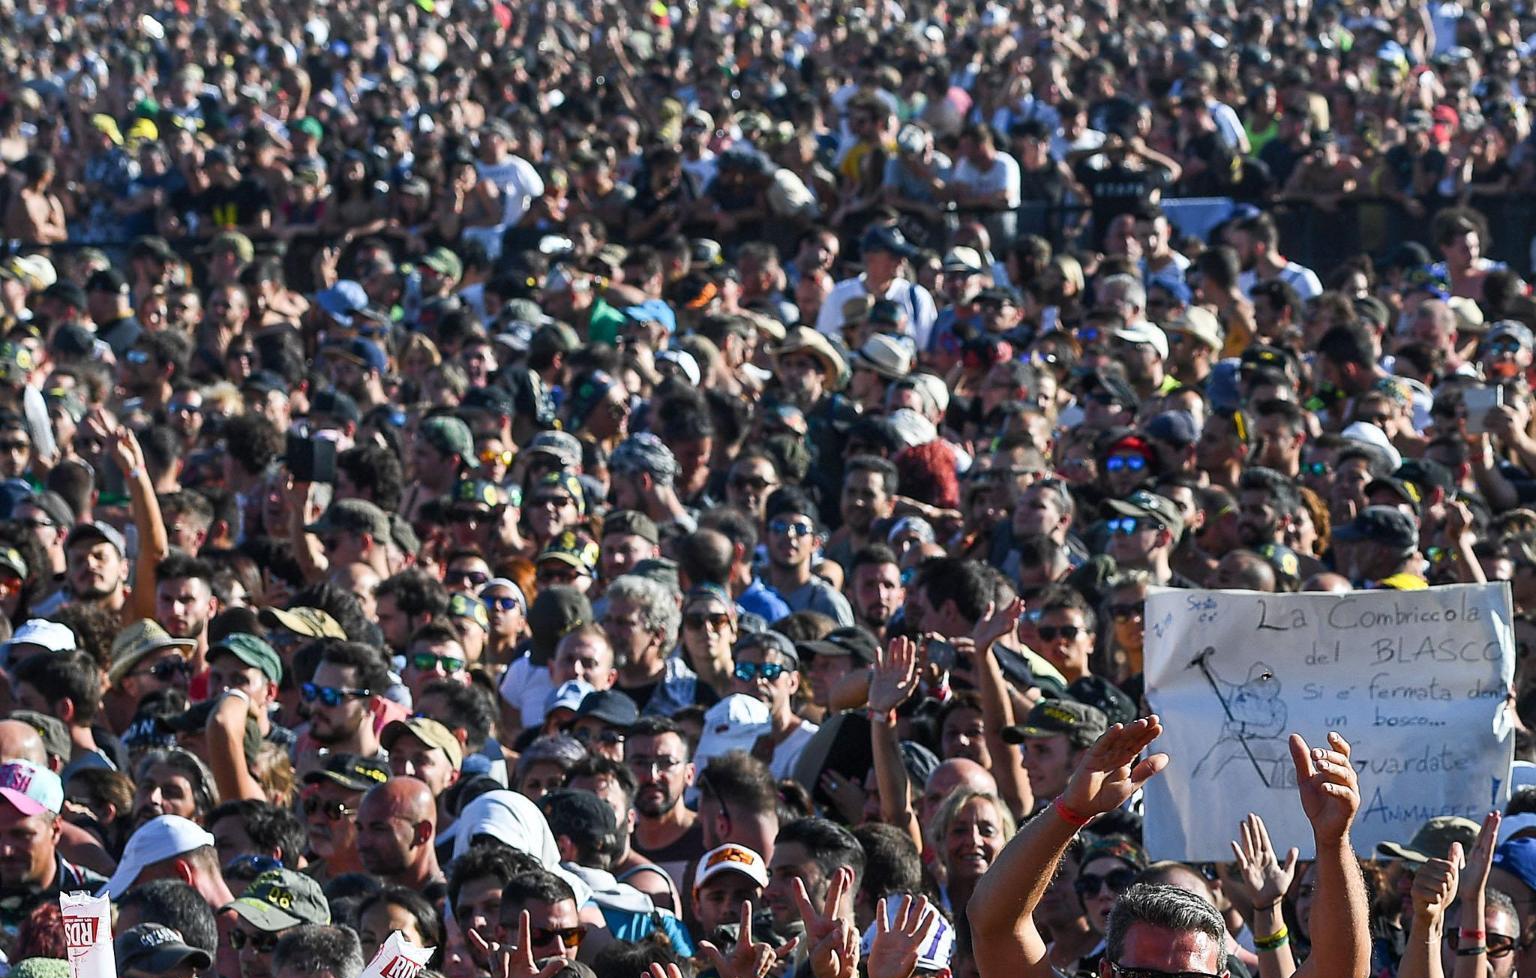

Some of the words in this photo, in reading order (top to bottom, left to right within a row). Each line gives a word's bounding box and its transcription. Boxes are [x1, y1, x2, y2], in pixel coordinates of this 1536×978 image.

[1256, 599, 1308, 631] La
[1328, 591, 1481, 631] Combriccola
[1305, 640, 1340, 666] del
[1369, 636, 1503, 667] BLASCO
[1369, 672, 1452, 702] fermata
[1324, 714, 1347, 727] un
